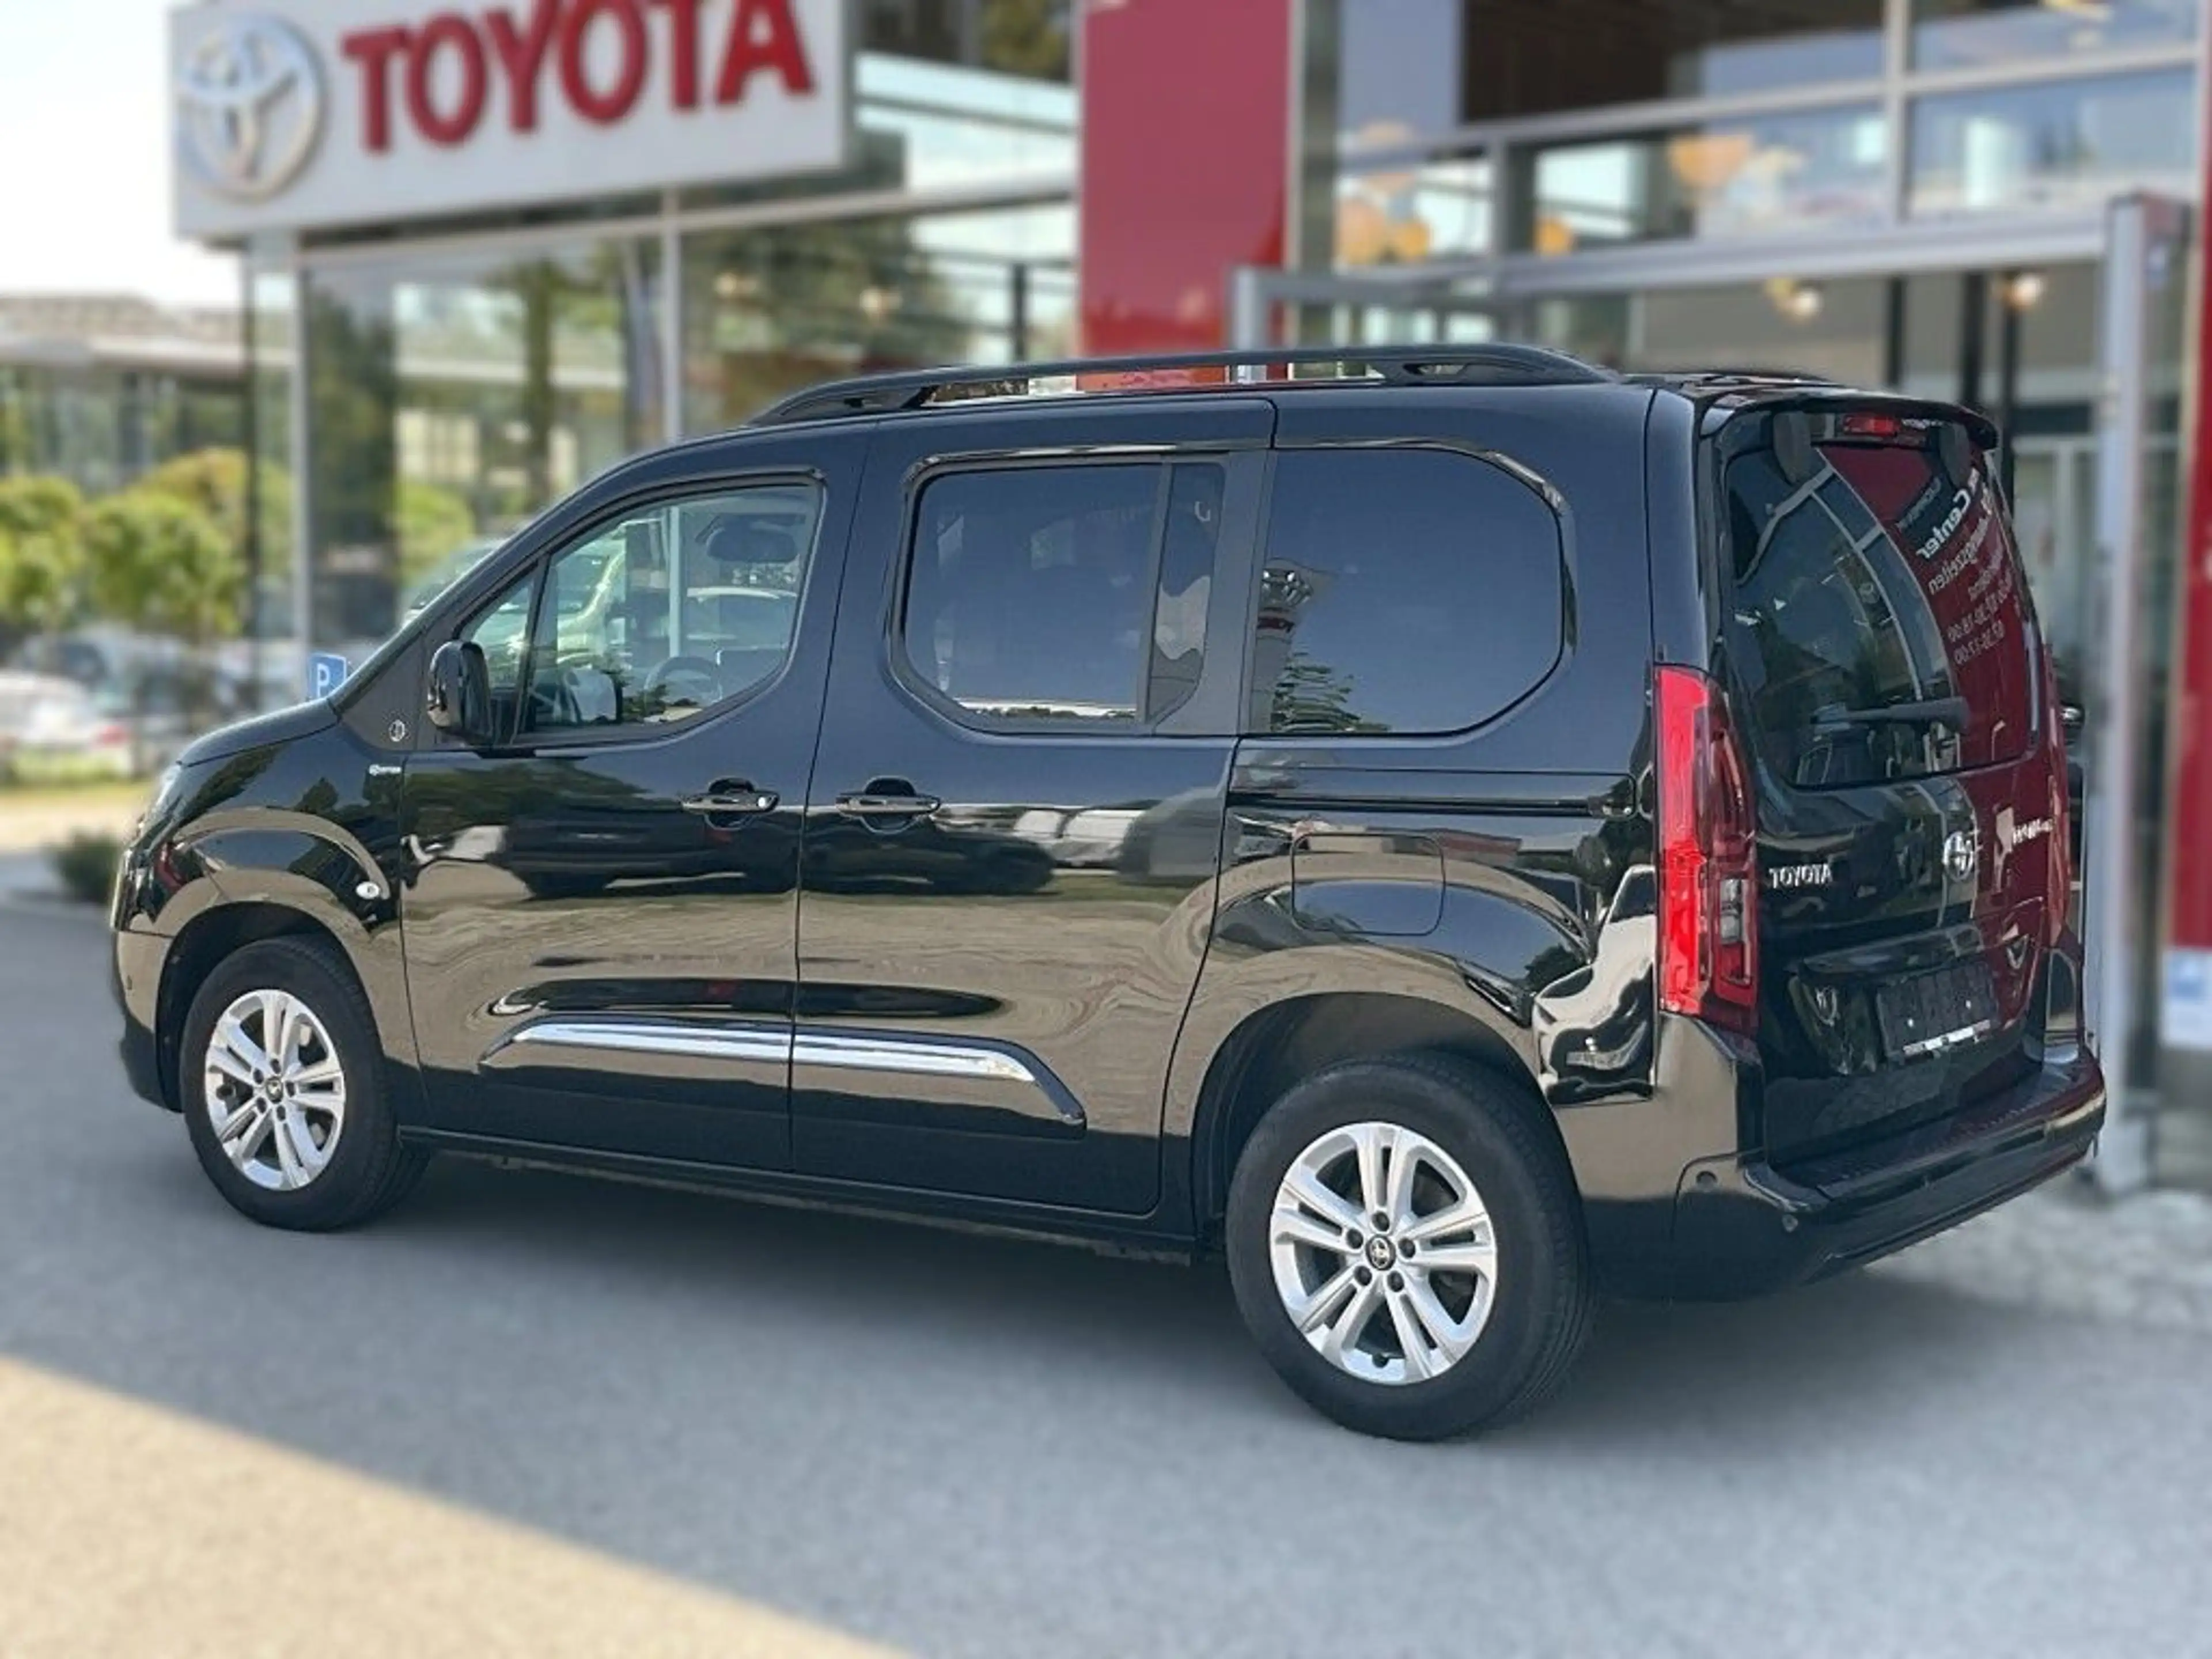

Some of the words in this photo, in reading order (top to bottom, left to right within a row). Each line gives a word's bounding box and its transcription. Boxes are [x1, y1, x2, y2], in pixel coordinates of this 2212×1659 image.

[339, 0, 816, 155] TOYOTA
[317, 662, 331, 696] P
[1768, 863, 1834, 889] TOYOTA
